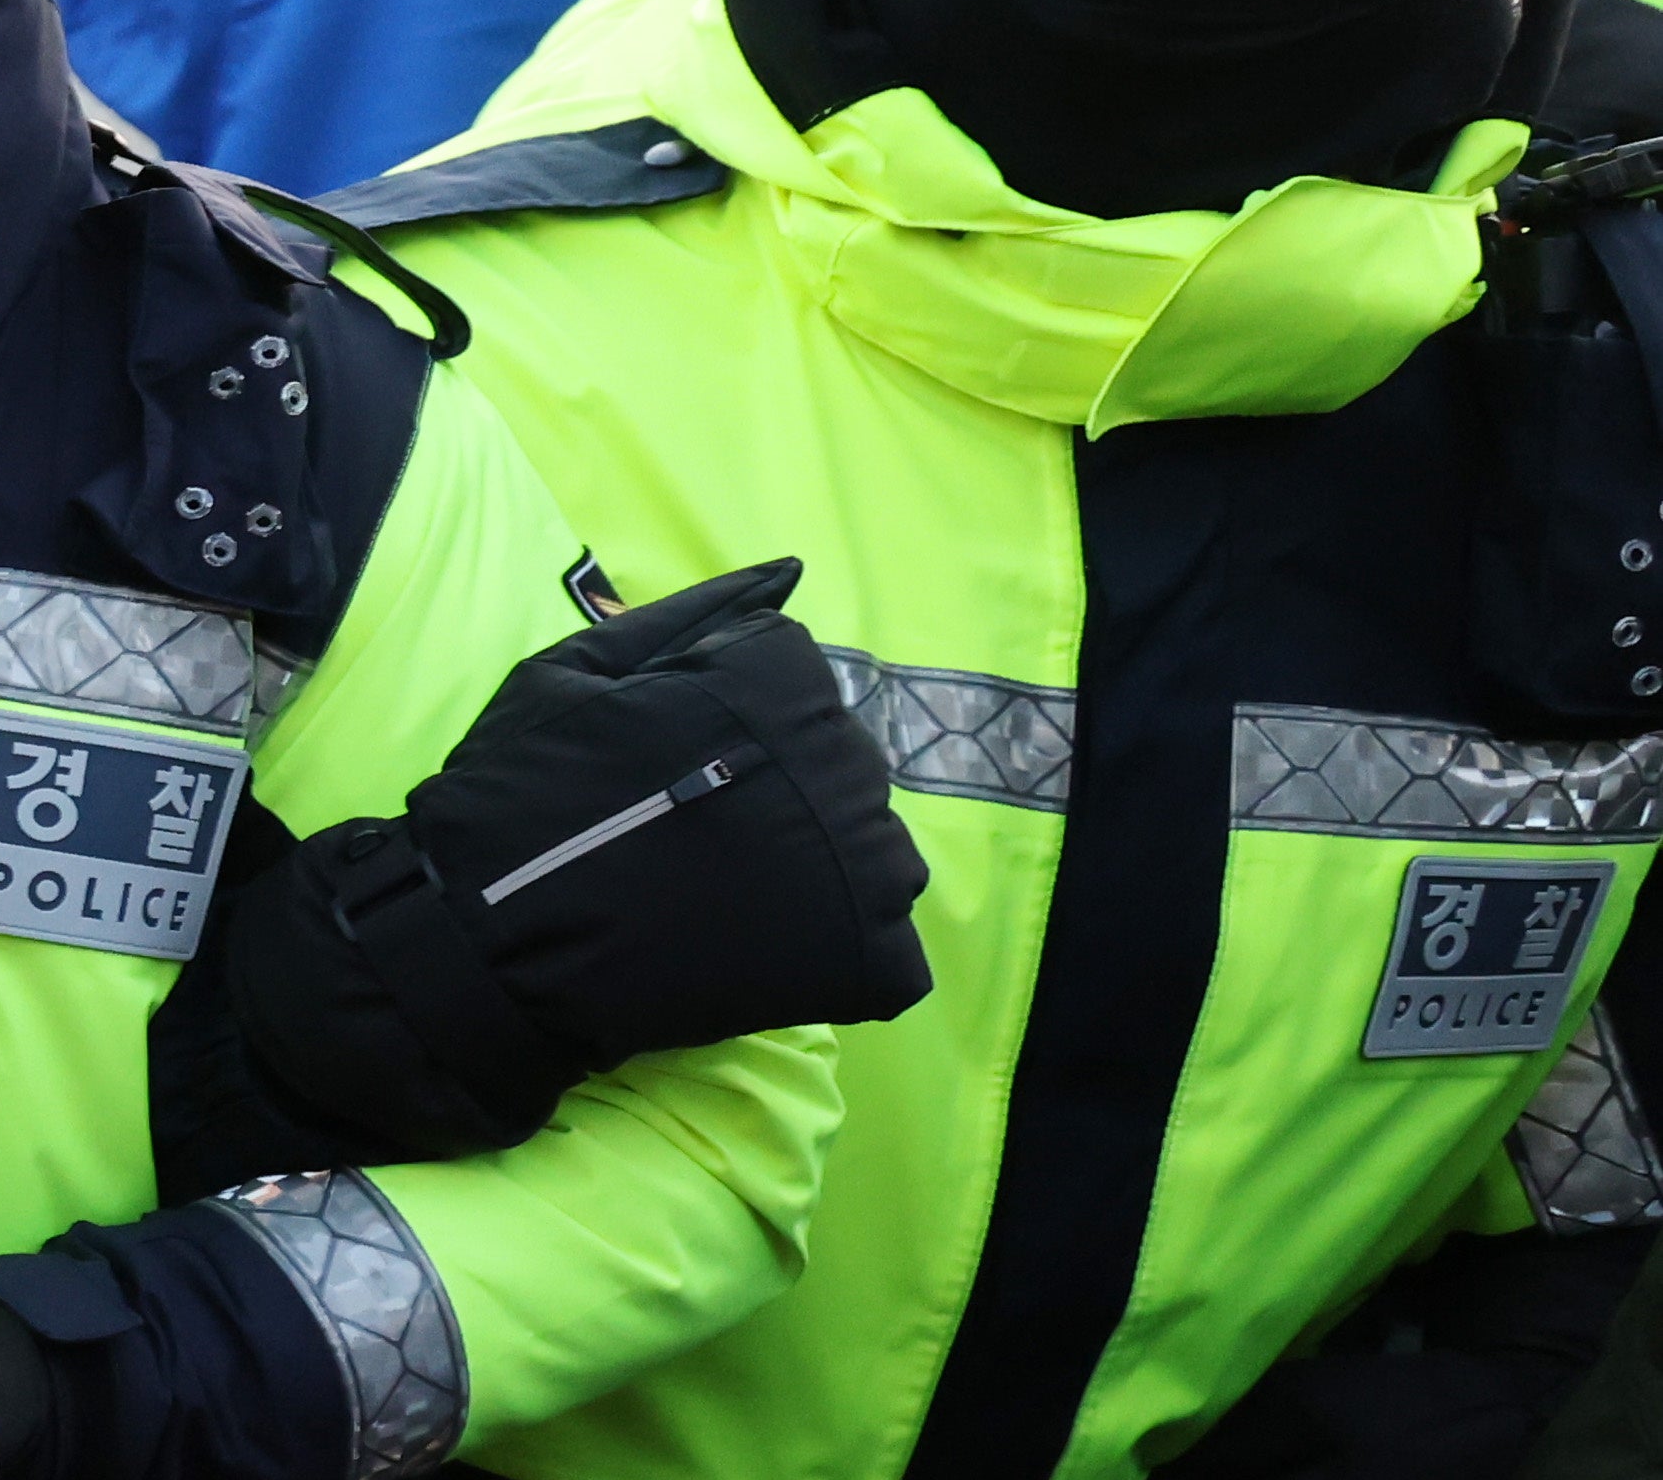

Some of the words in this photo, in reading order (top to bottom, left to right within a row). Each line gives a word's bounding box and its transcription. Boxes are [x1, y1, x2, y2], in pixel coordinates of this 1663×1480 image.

[6, 741, 215, 865] 경찰
[1421, 883, 1584, 971] 경찰
[1387, 990, 1546, 1032] POLICE
